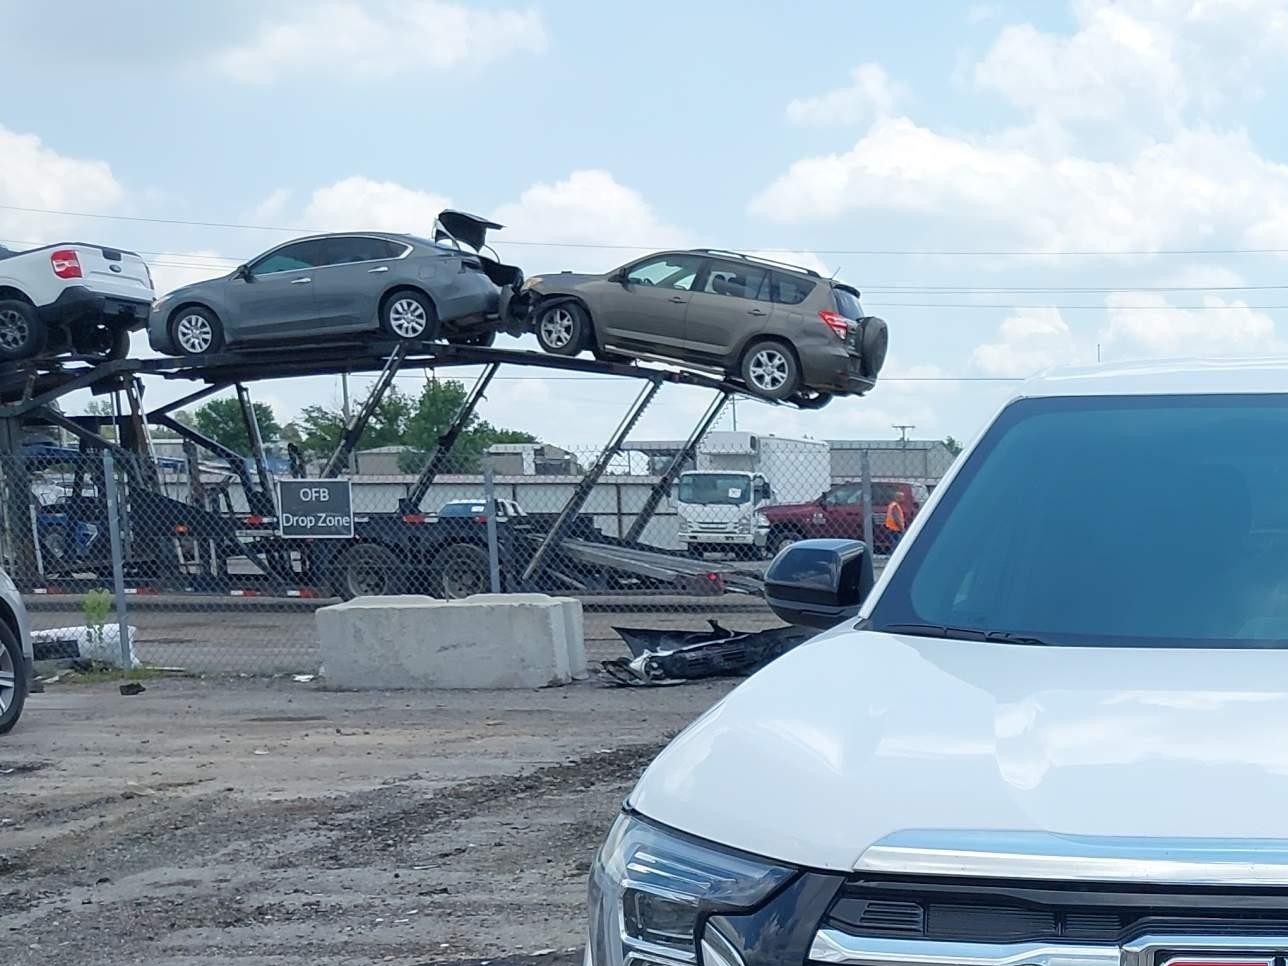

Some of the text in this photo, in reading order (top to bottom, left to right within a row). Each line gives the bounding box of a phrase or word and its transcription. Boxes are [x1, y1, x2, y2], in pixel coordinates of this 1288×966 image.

[300, 488, 329, 501] OFB
[282, 513, 350, 528] Drop Zone
